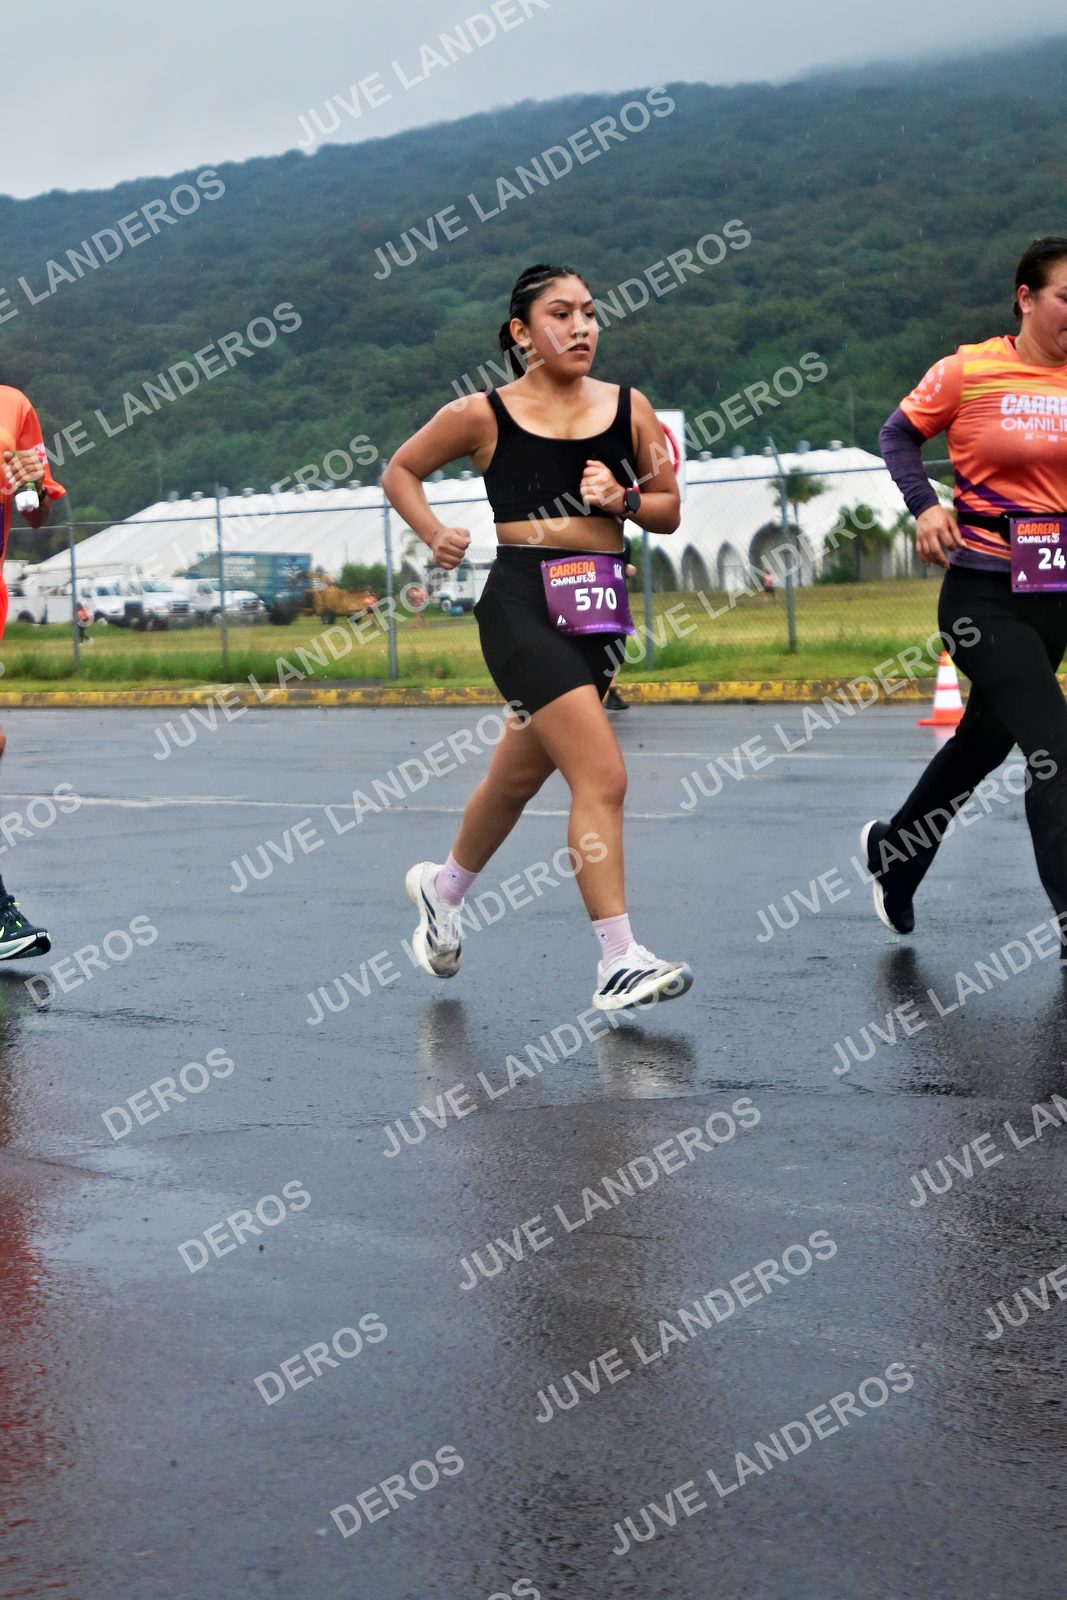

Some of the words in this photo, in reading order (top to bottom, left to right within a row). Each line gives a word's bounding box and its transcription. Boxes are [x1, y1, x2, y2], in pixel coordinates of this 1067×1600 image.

[1017, 523, 1060, 535] CARRERA
[549, 561, 596, 579] CARRERA
[575, 587, 617, 611] 570
